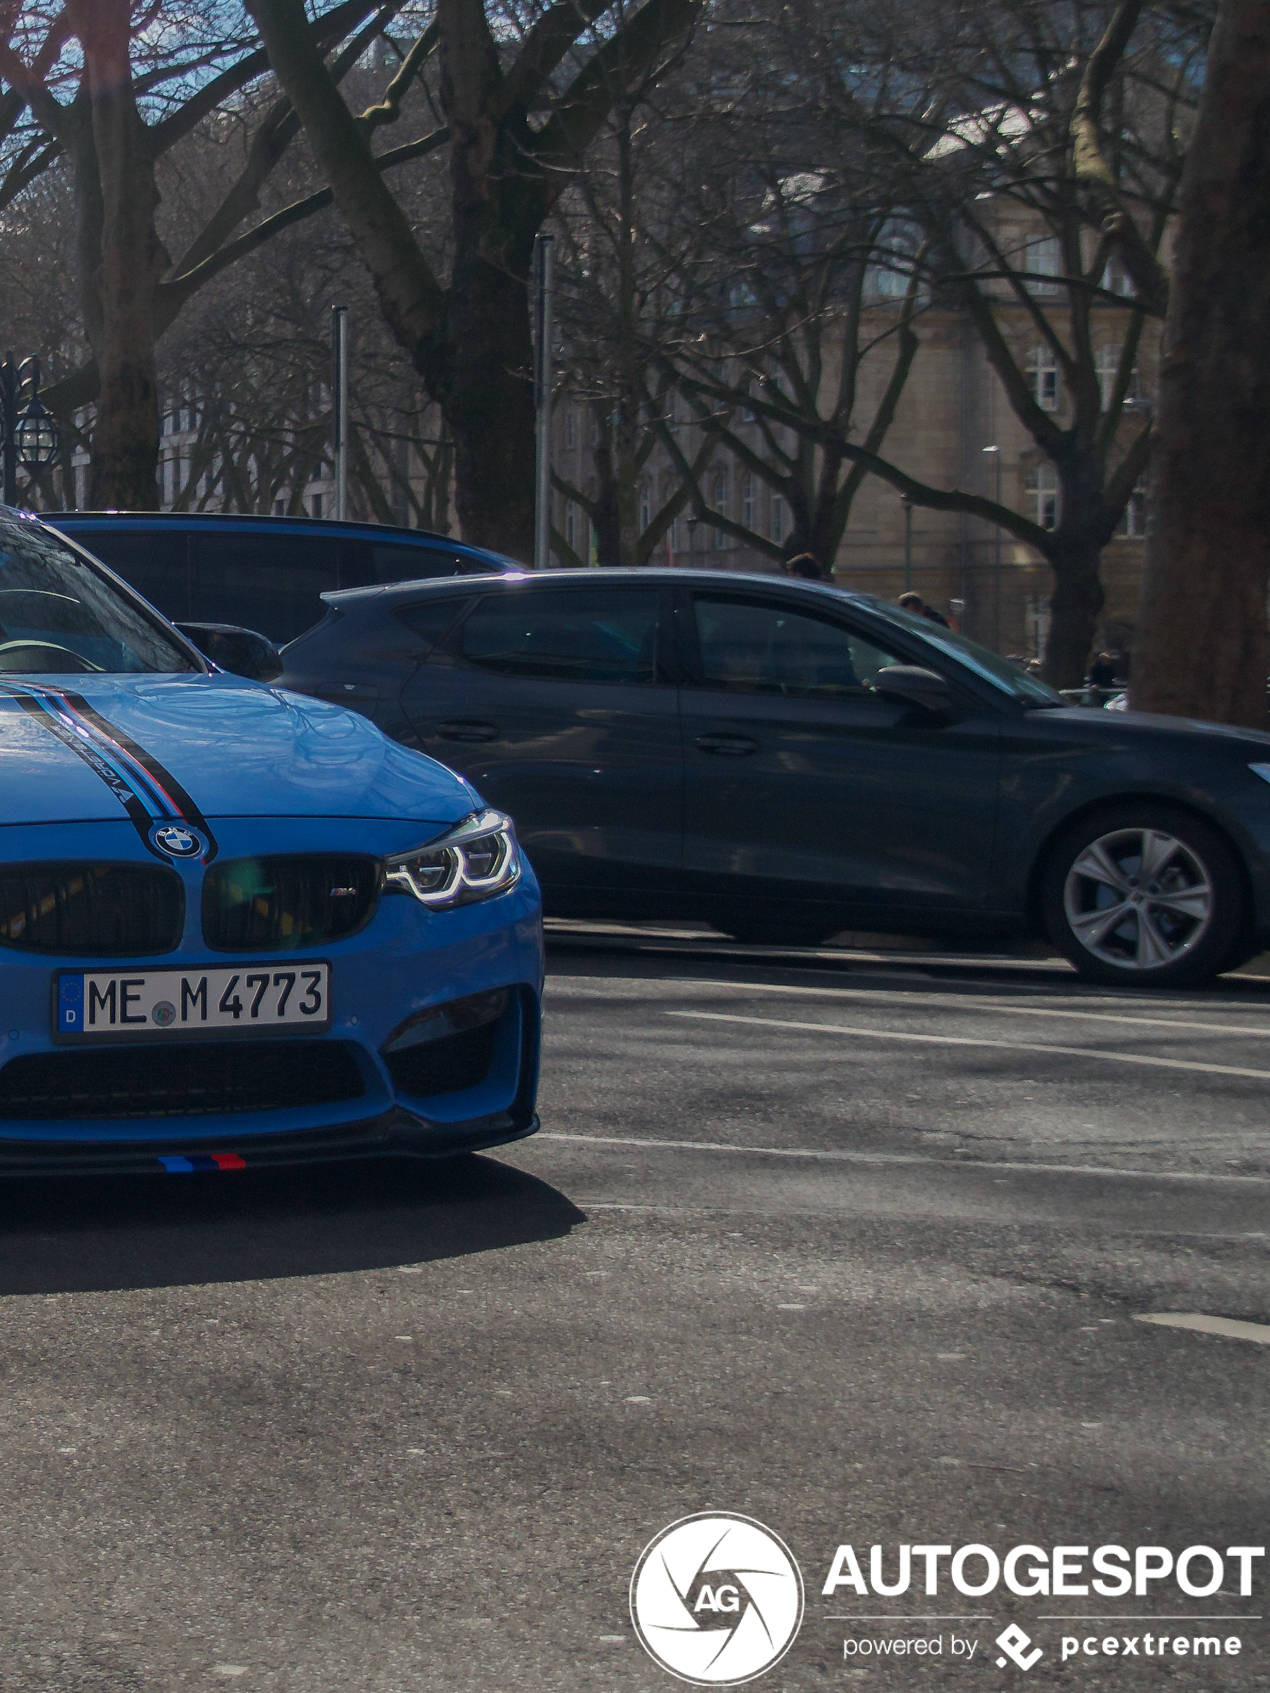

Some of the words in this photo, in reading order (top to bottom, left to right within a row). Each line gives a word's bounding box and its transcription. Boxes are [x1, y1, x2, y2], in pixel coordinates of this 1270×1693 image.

[87, 978, 147, 1025] ME
[180, 976, 208, 1022] M
[218, 970, 322, 1019] 4773
[65, 1009, 76, 1023] D
